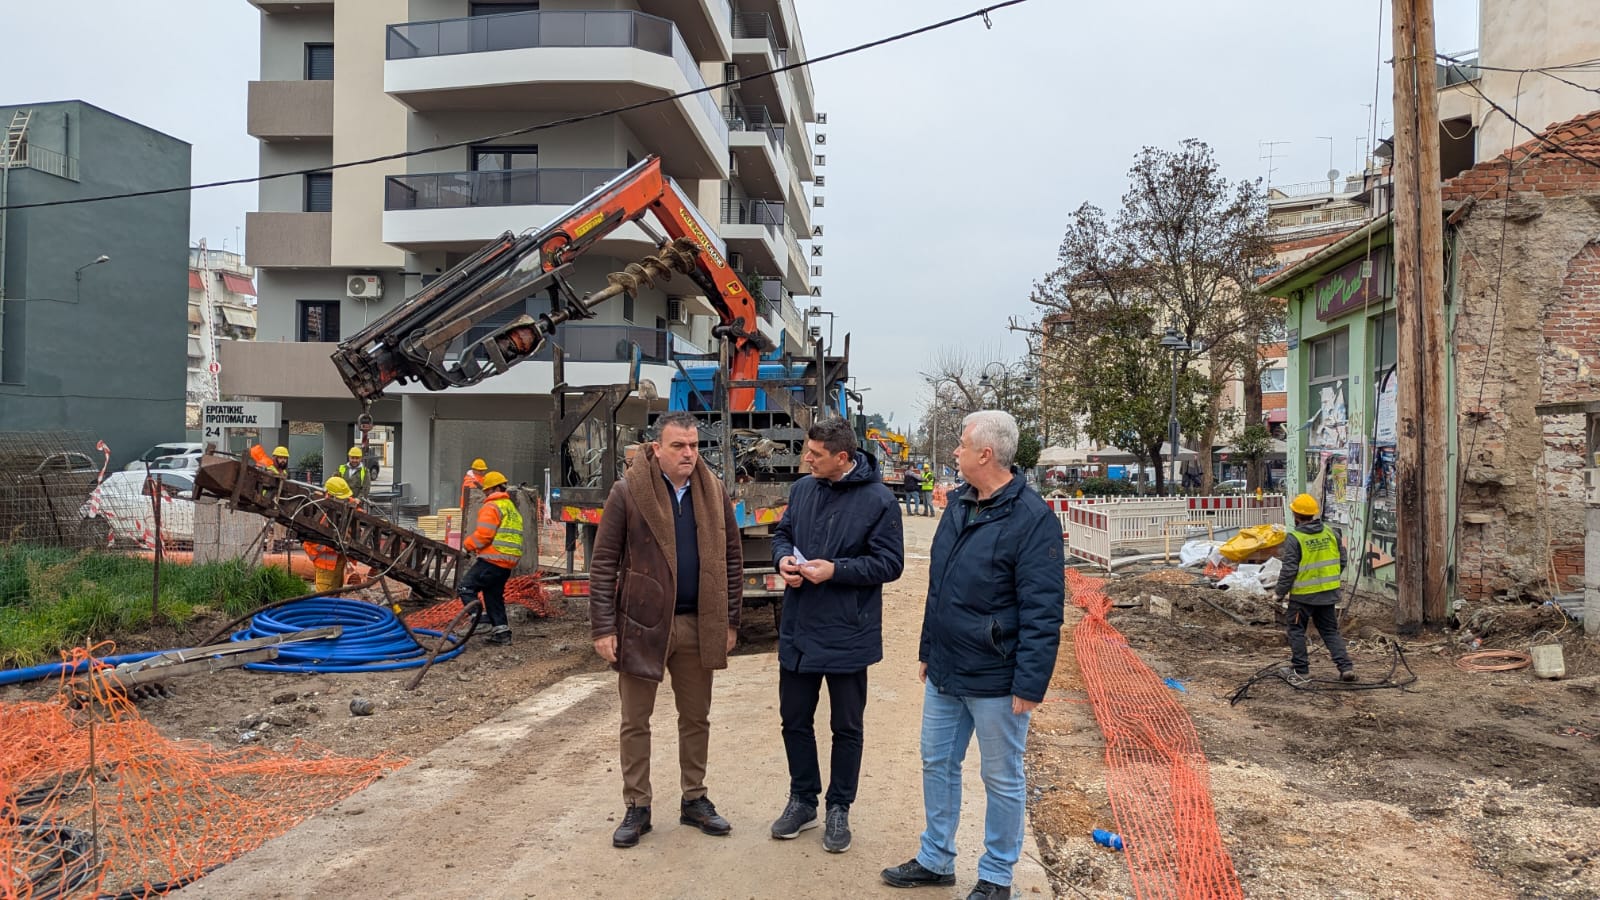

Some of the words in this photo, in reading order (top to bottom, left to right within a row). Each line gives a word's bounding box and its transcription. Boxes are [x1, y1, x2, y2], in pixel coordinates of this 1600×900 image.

[813, 112, 827, 207] HOTEL
[206, 405, 244, 414] ΕΡΓΑΤΙΚΗΣ
[206, 415, 257, 424] ΠΡΩΤΟΜΑΓΙΑΣ
[205, 427, 220, 437] 2-4
